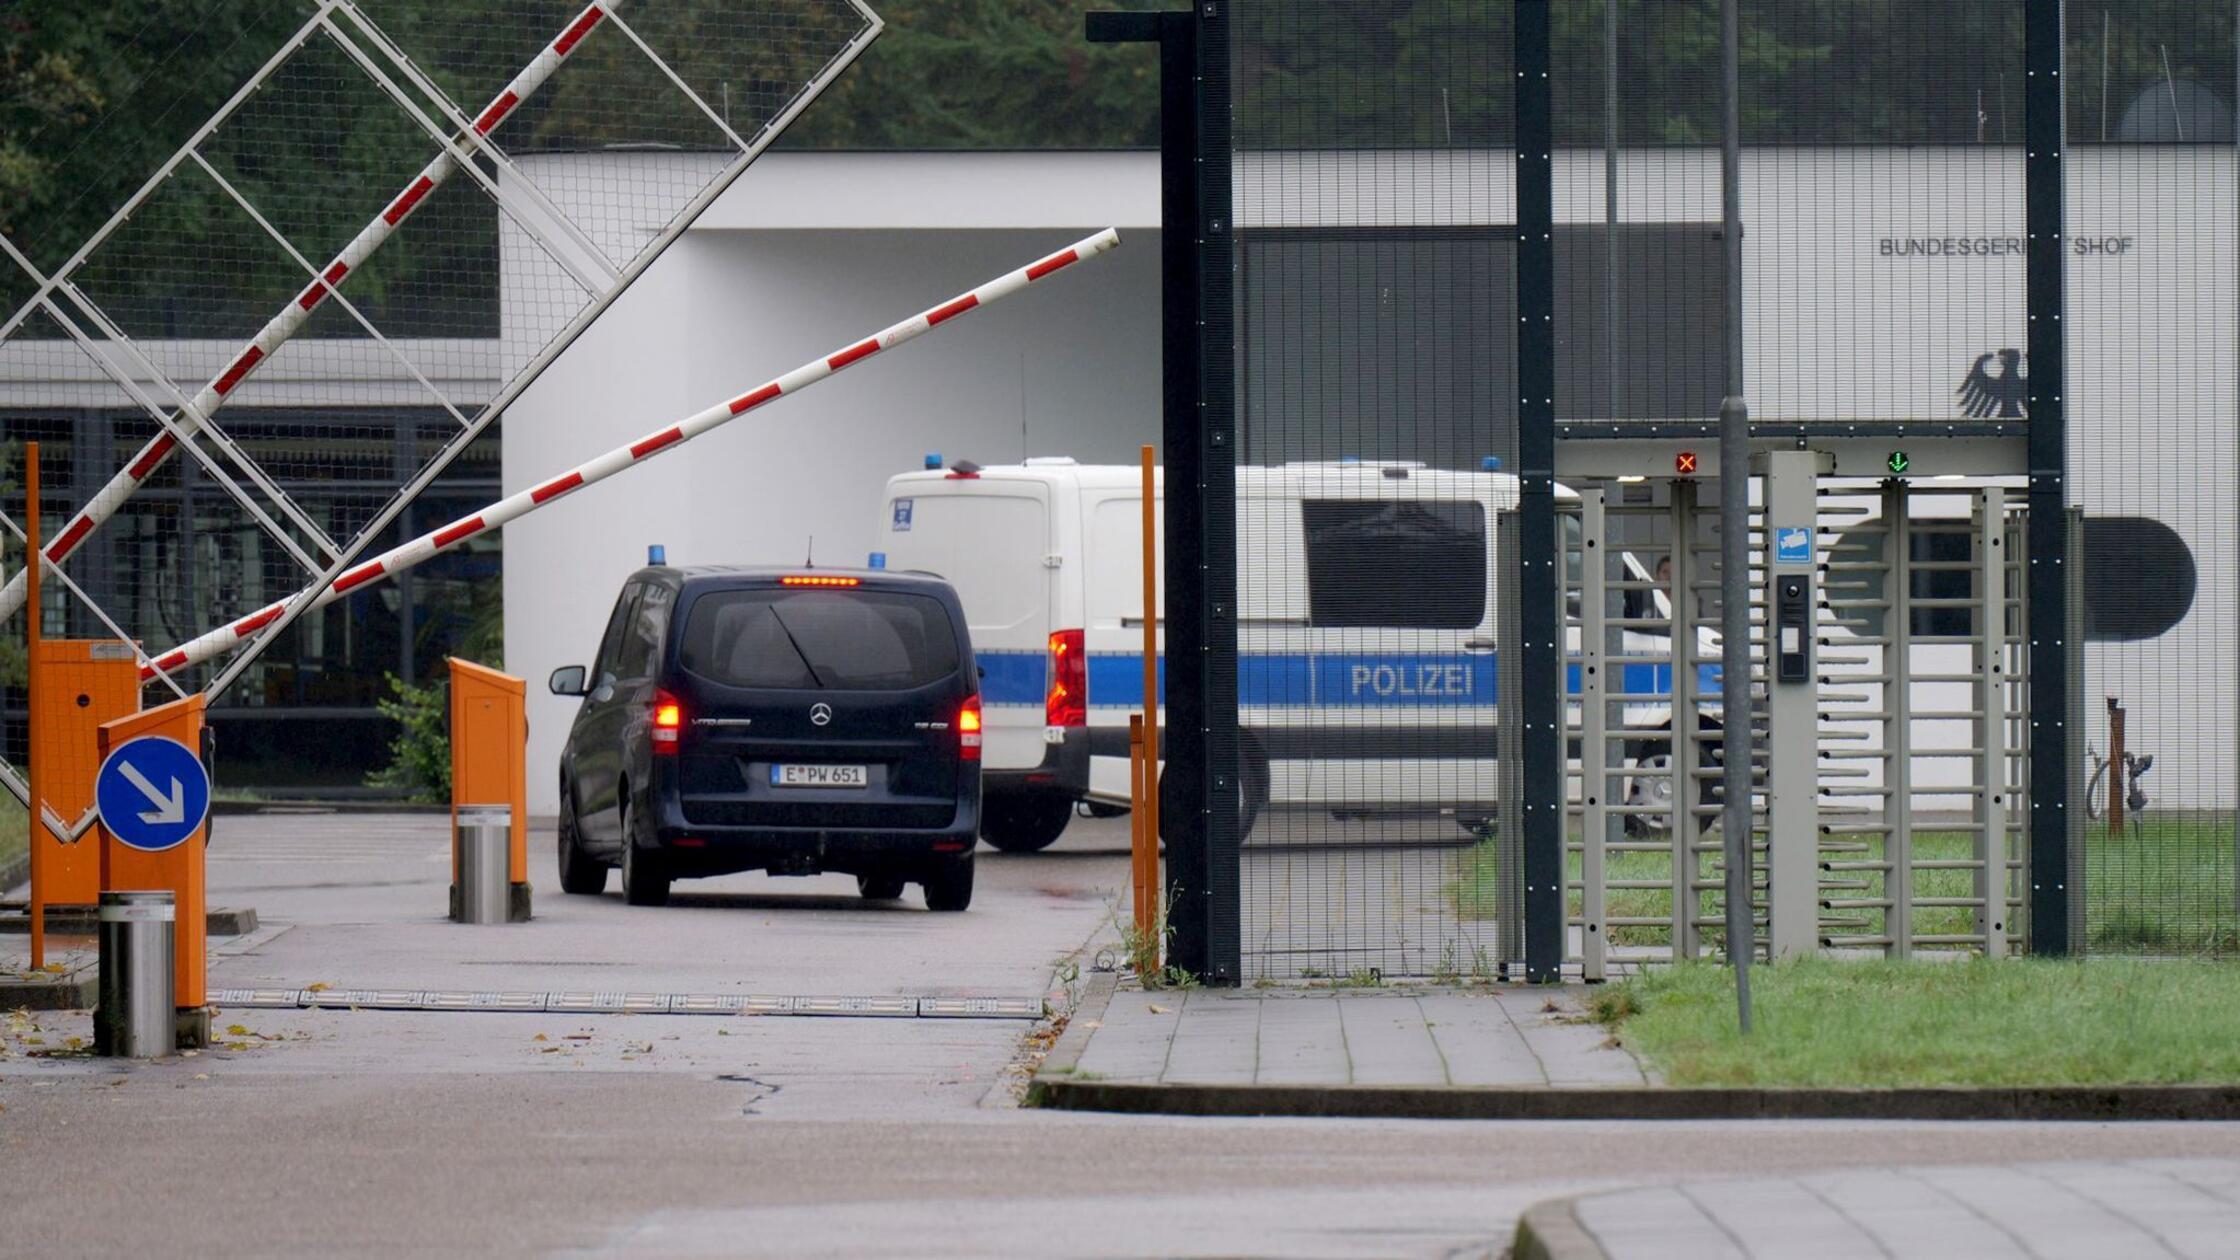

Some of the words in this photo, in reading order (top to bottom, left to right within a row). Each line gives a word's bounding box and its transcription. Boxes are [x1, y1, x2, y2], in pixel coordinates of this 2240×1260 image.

[1880, 237, 2133, 256] BUNDESGERISHOF
[1351, 664, 1472, 695] POLIZEI
[832, 766, 861, 783] 651
